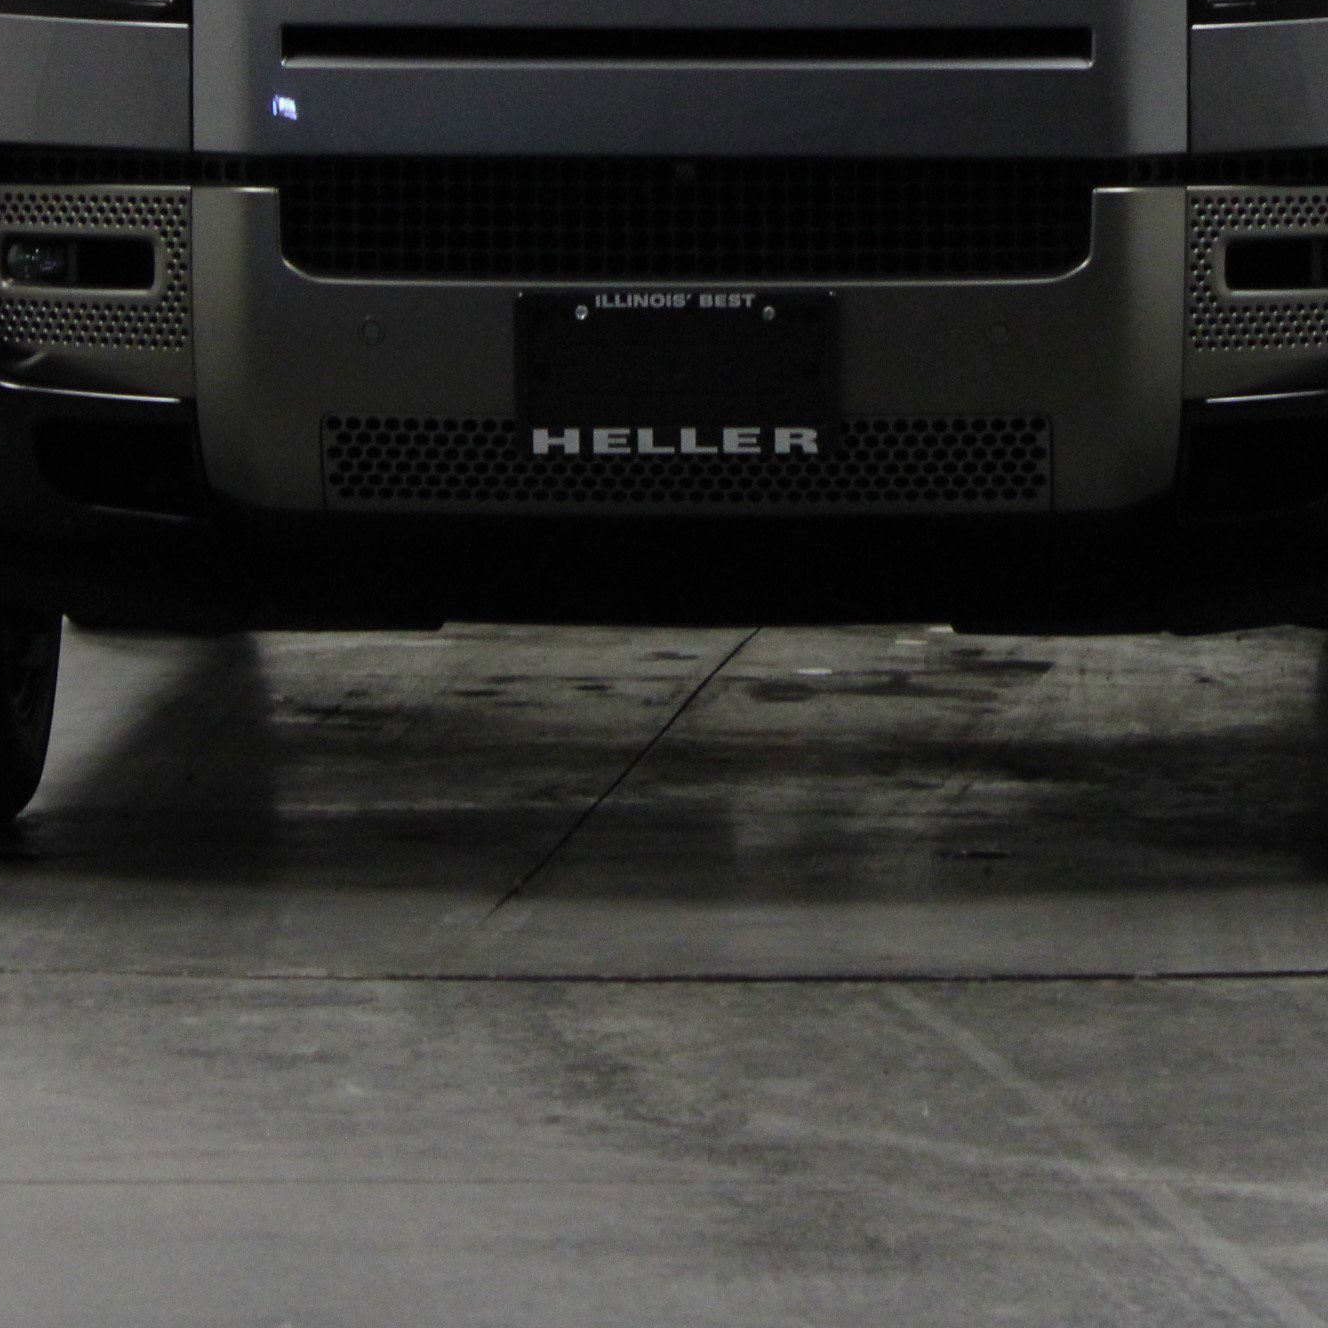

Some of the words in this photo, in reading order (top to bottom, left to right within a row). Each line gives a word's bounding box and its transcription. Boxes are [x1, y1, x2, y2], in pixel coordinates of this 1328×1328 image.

[595, 294, 692, 308] ILLINOIS'
[699, 294, 755, 308] BEST
[532, 427, 819, 455] HELLER
